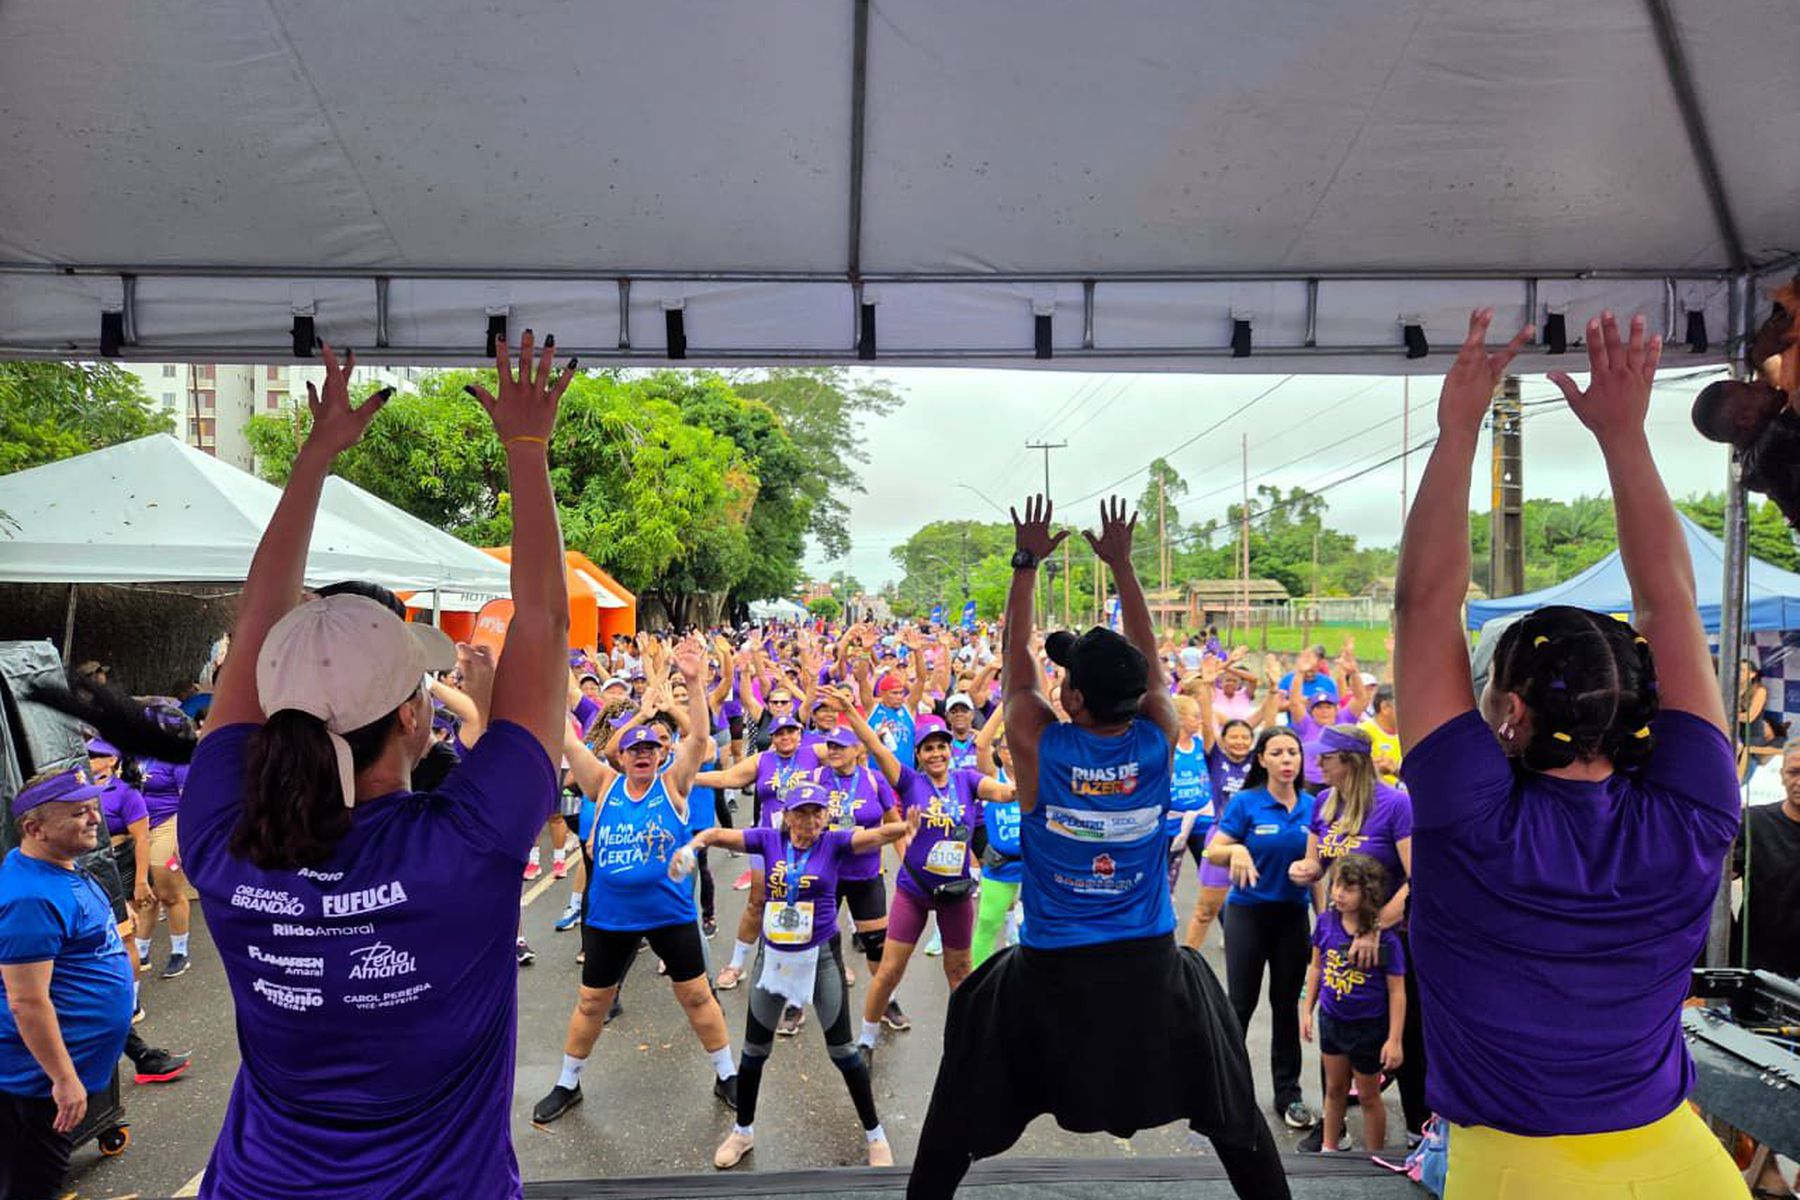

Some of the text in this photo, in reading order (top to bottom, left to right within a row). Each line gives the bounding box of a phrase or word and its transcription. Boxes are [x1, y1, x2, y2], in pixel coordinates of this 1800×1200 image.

[1072, 762, 1139, 781] RUAS DE
[598, 825, 645, 847] MEDIDA
[617, 824, 634, 835] NA
[297, 867, 344, 881] APOIO
[235, 884, 289, 902] ORLEANS
[322, 881, 408, 916] FUFUCA
[350, 940, 409, 969] Perla
[285, 966, 323, 977] Amaral
[348, 956, 417, 979] Amaral
[343, 982, 432, 1003] CAROL PEREIRA
